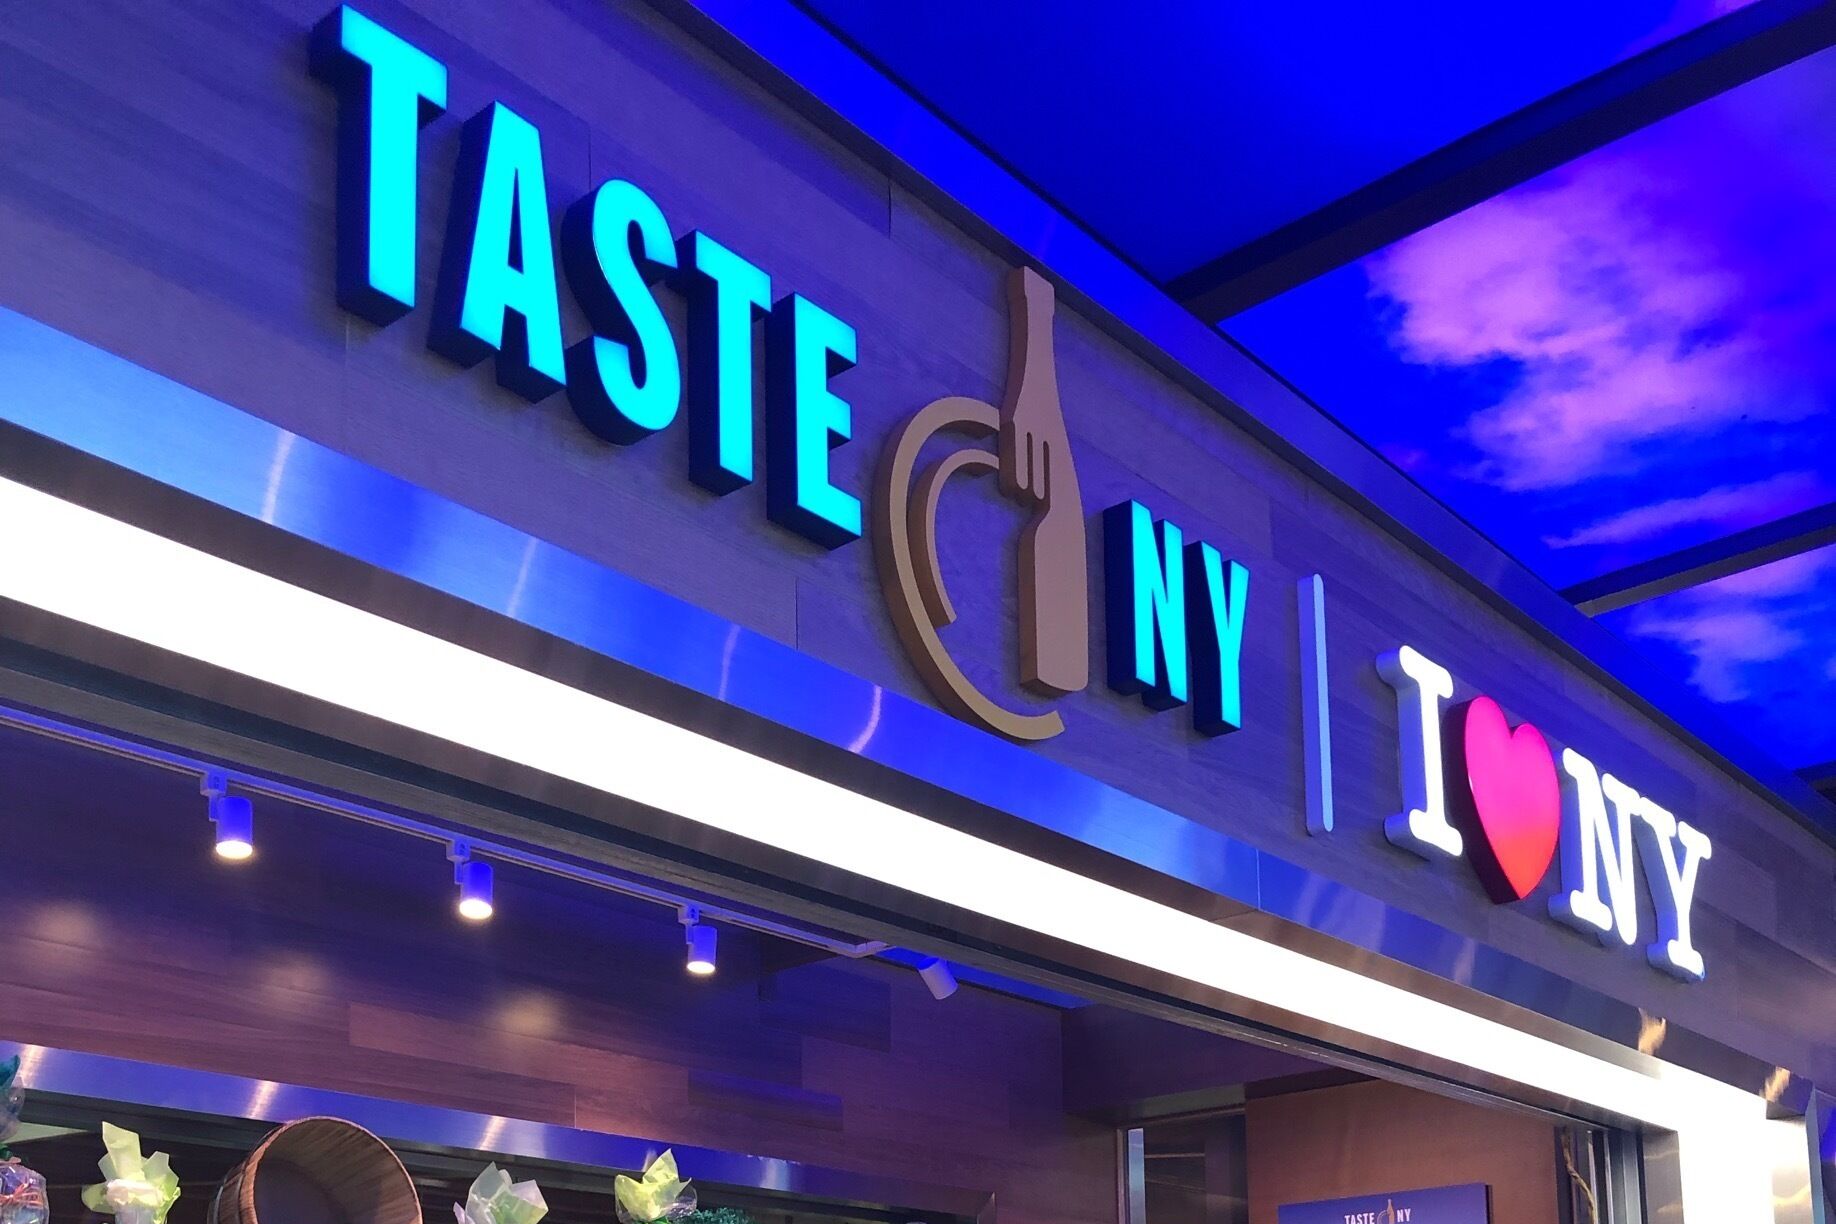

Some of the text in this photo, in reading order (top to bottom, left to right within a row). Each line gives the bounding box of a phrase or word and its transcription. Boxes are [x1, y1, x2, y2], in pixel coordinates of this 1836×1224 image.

[336, 3, 1250, 732] TASTE NY
[1396, 644, 1712, 982] I NY
[1397, 1208, 1412, 1223] NY
